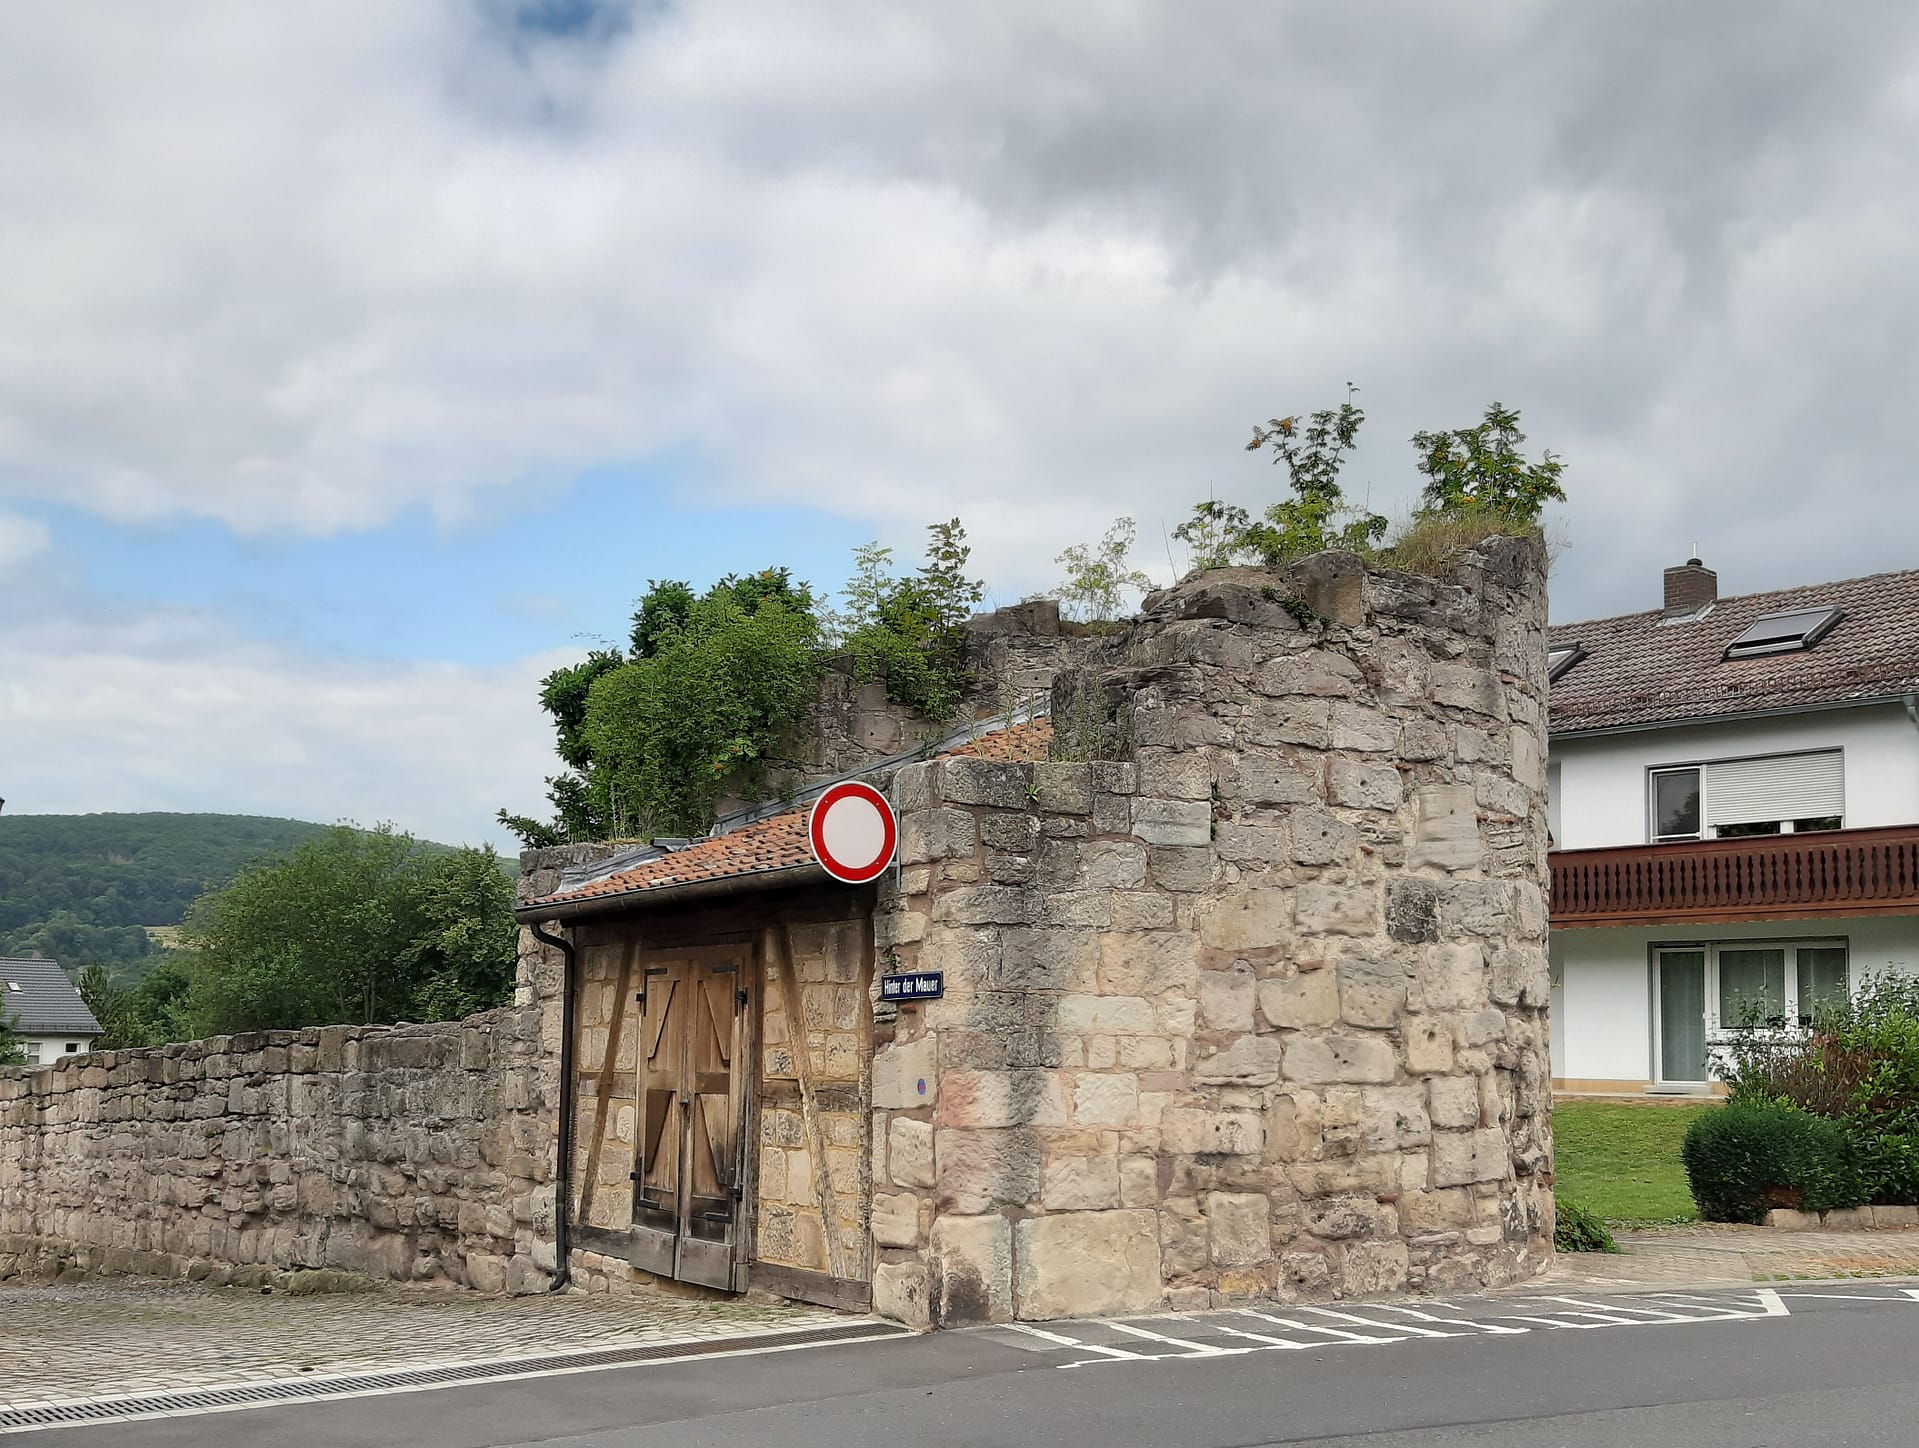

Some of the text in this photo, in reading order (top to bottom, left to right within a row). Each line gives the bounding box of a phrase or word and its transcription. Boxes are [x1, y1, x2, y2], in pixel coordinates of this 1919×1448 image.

[884, 977, 938, 995] Hinter der Mauer
